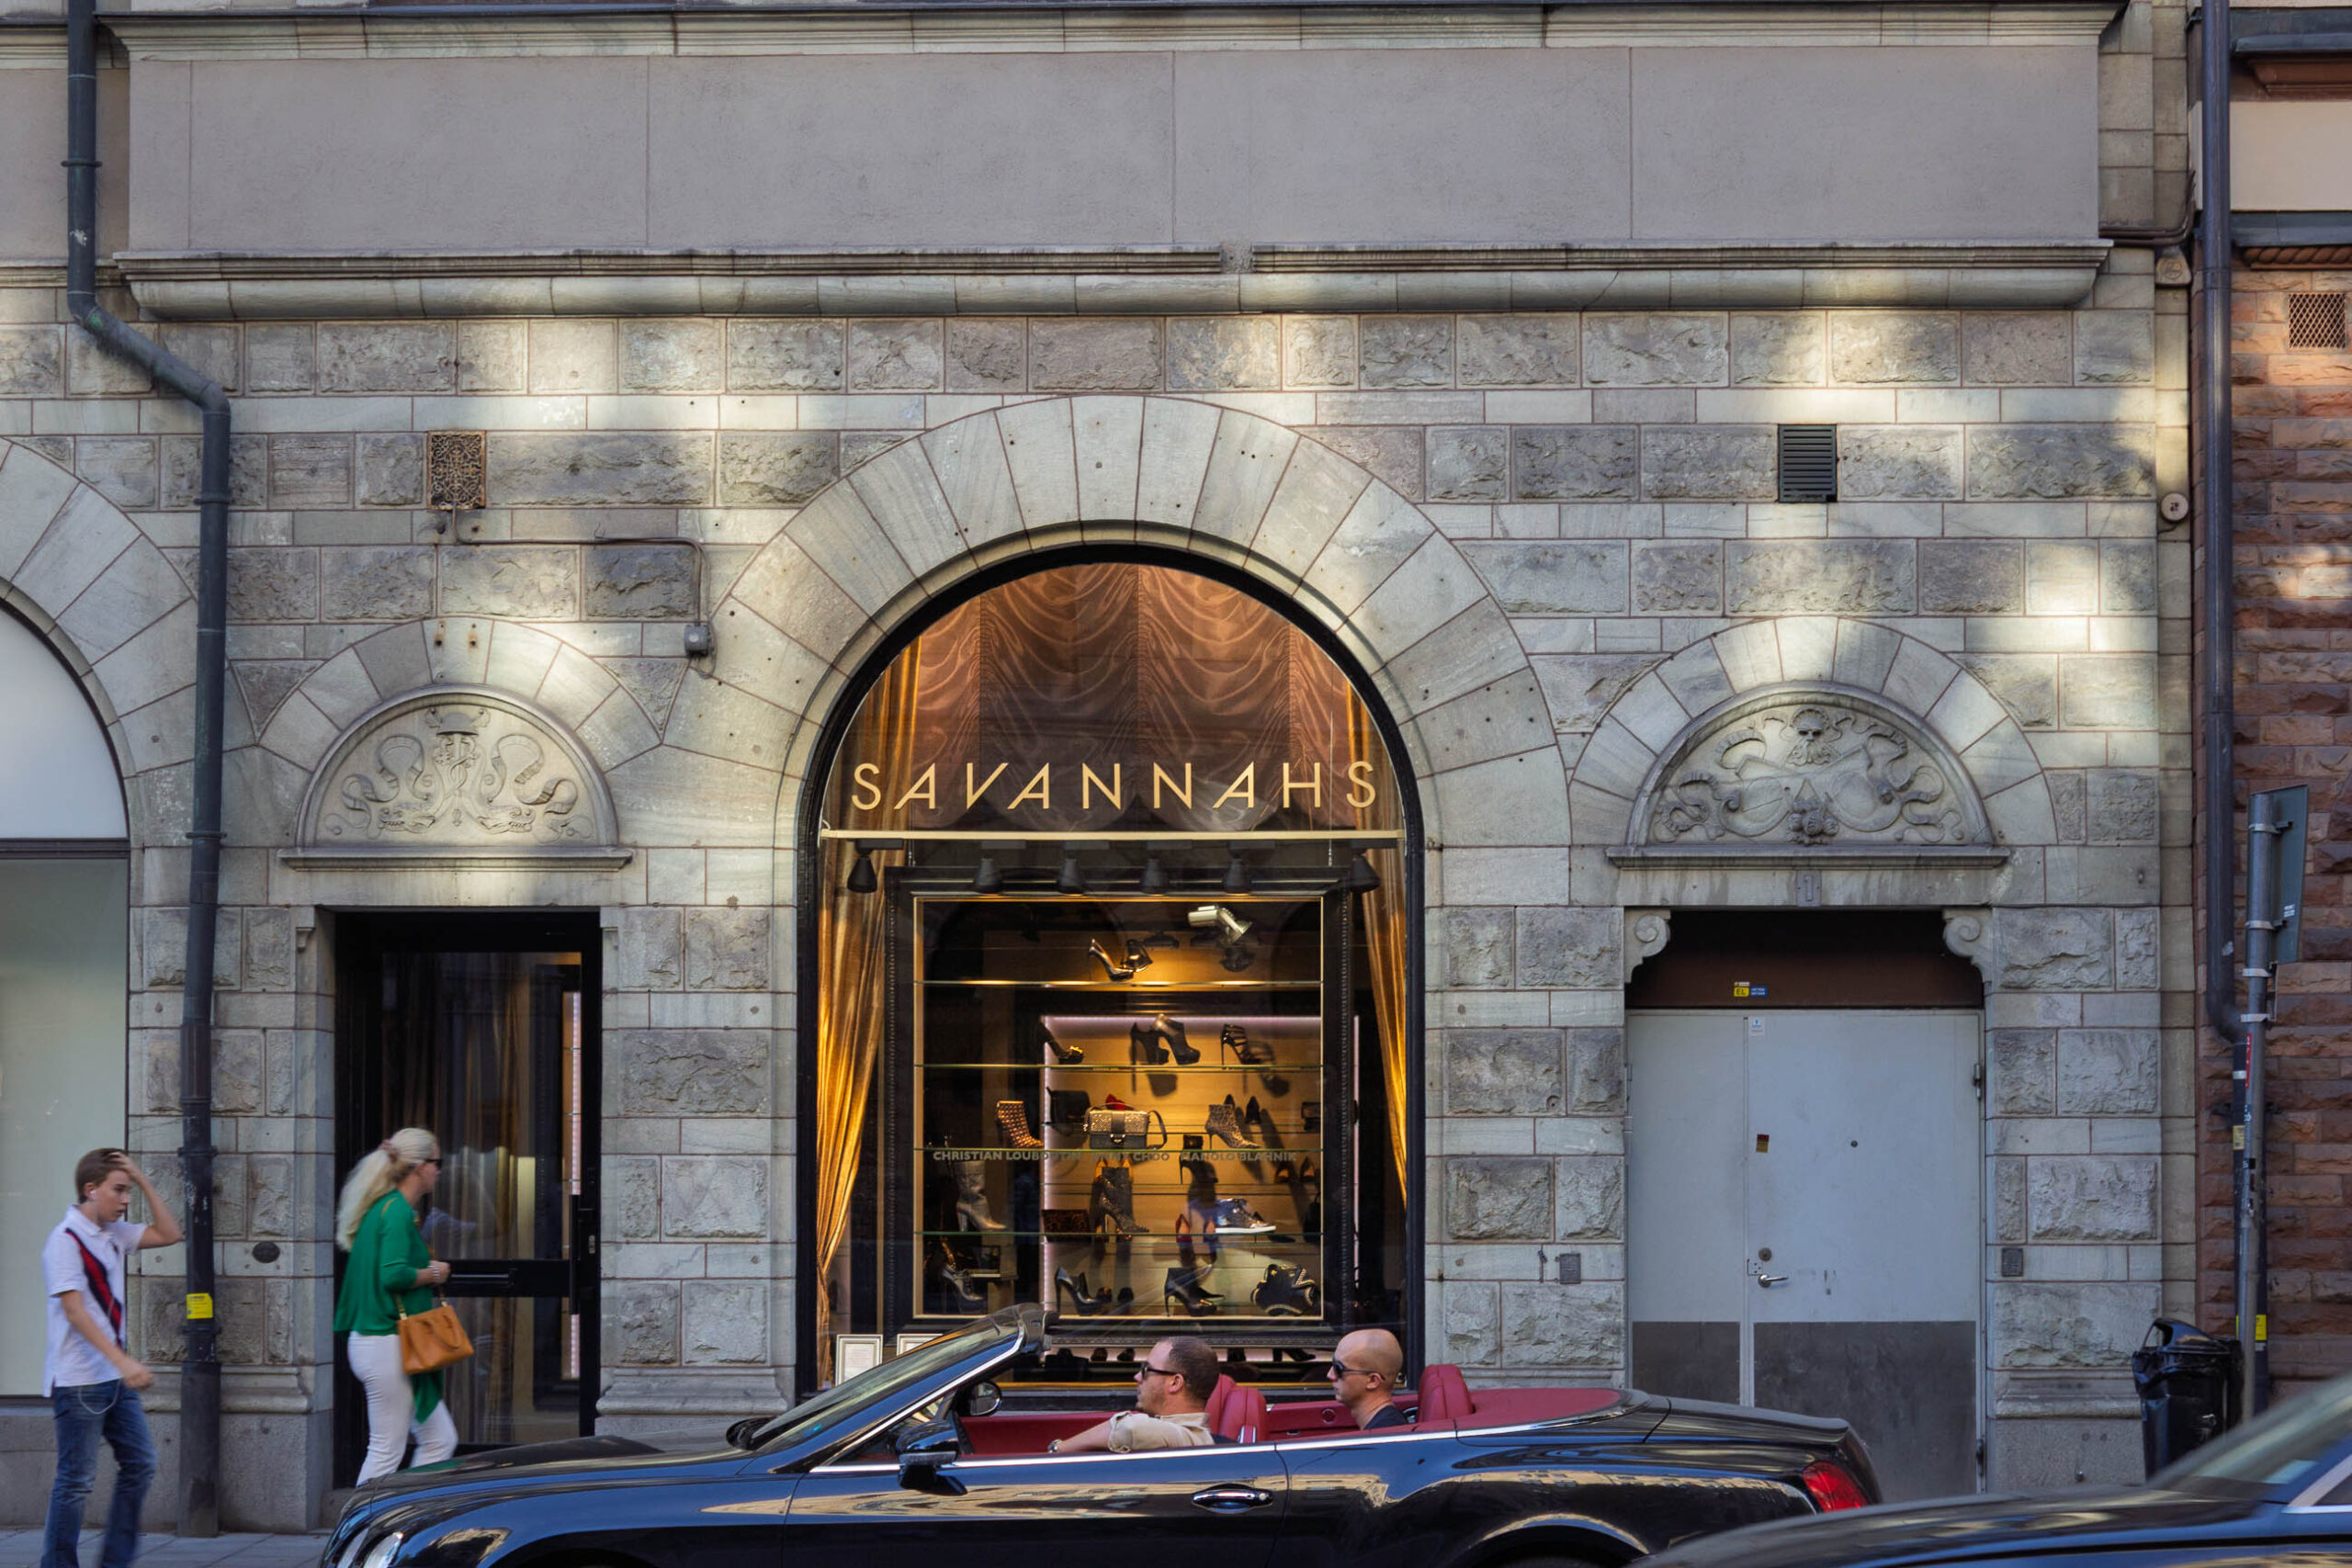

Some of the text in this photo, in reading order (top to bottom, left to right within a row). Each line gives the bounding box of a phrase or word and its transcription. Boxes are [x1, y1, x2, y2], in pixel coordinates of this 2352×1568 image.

[852, 761, 1376, 810] SAVANNAHS
[933, 1151, 1002, 1161] CHRISTIAN
[1133, 1152, 1170, 1162] CHOO
[1240, 1151, 1297, 1162] BLAHNIK
